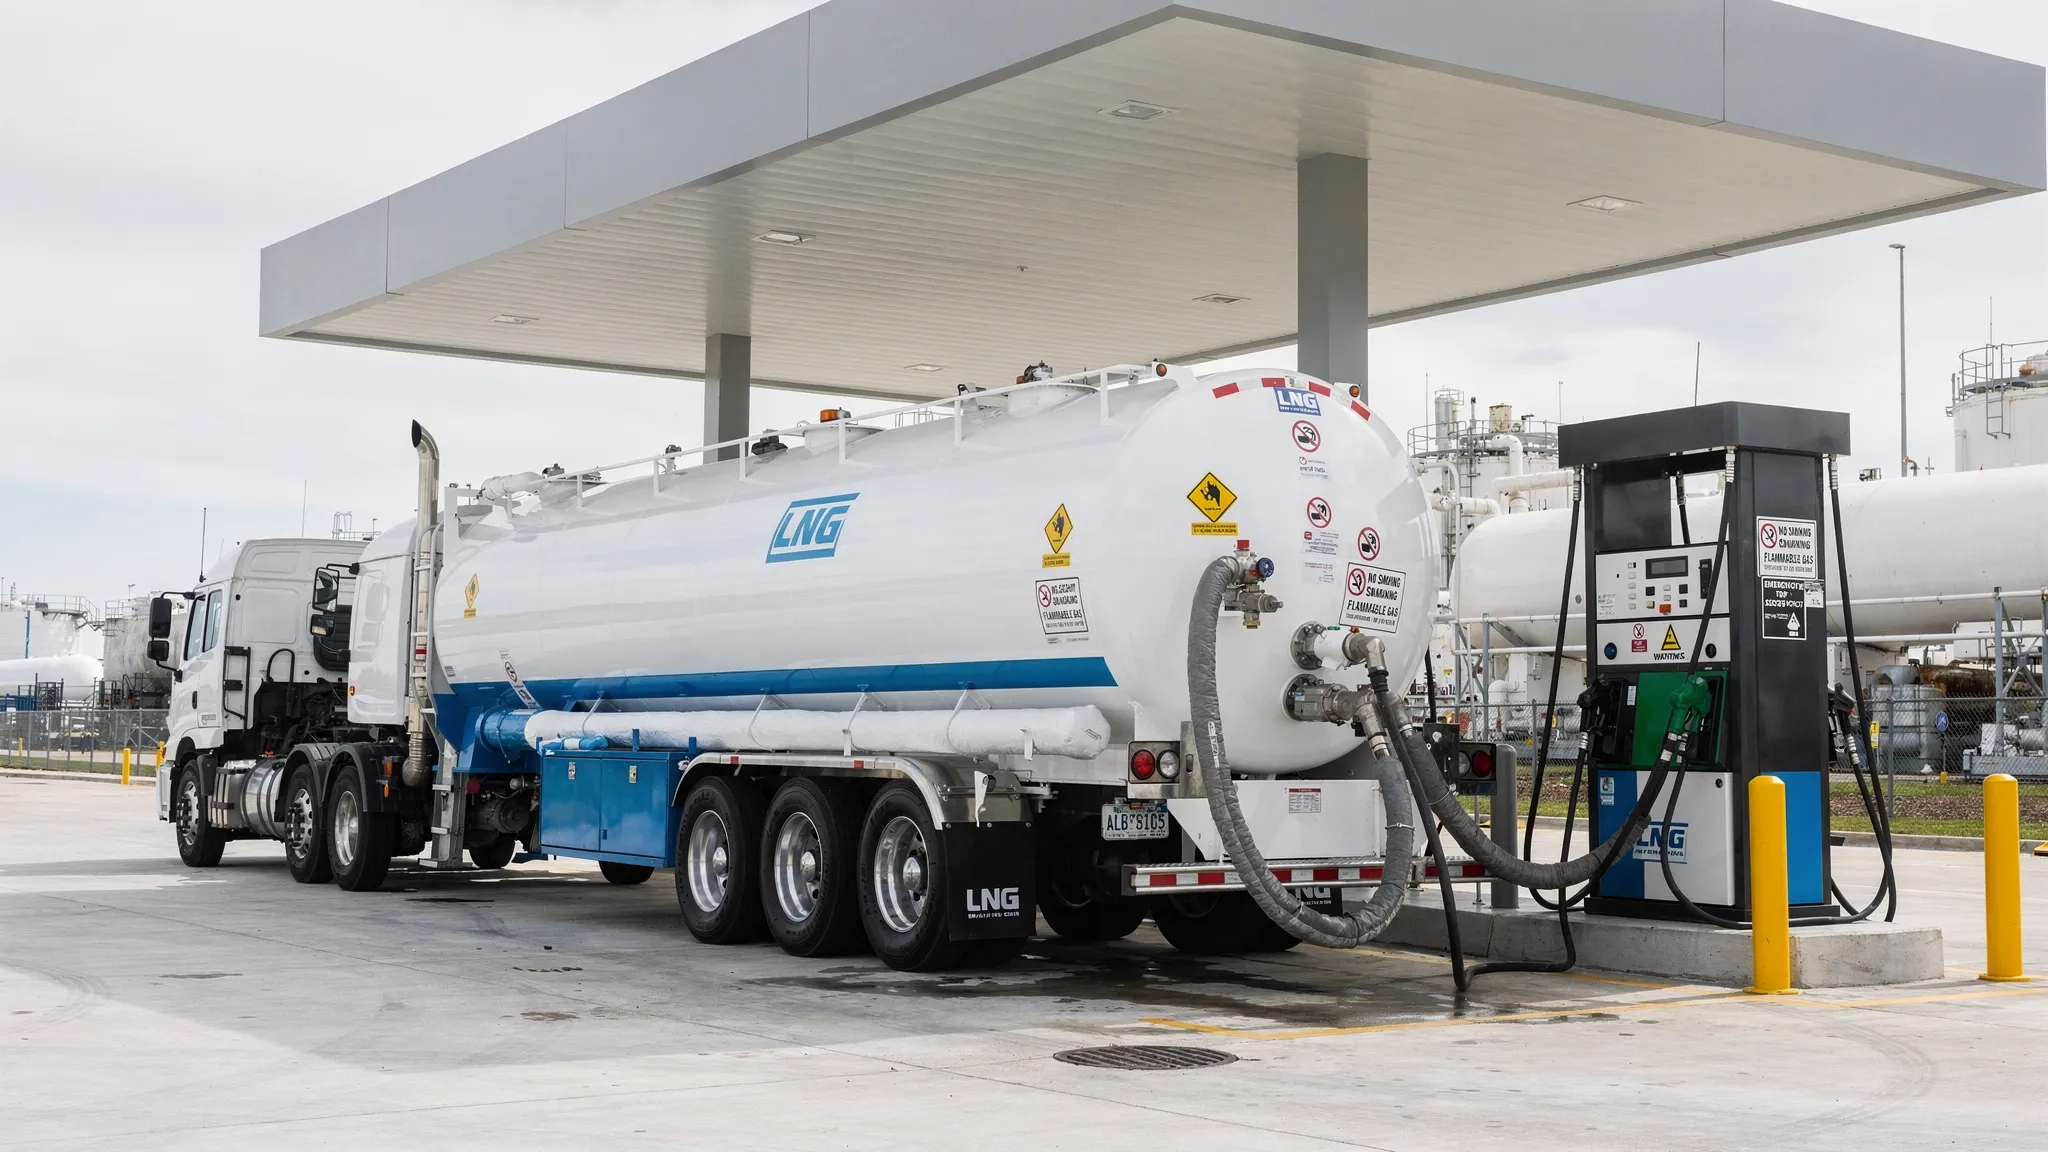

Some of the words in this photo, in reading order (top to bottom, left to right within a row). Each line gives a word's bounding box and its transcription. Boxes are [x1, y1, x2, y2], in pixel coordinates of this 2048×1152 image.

[1277, 390, 1318, 409] LNG
[773, 504, 850, 548] LNG
[1802, 554, 1814, 565] GAS
[1107, 814, 1129, 831] ALB
[966, 887, 1020, 911] LNG
